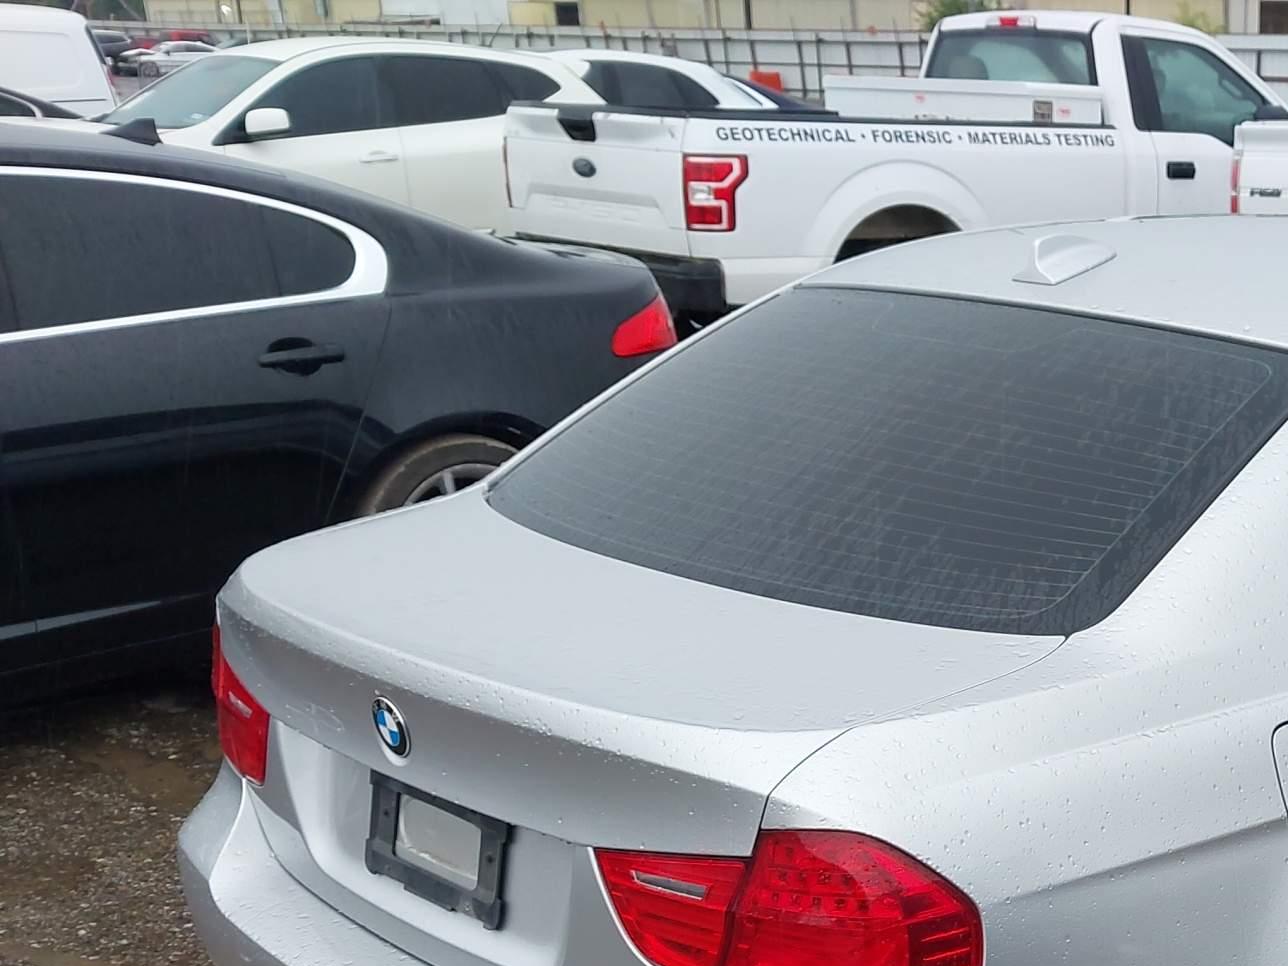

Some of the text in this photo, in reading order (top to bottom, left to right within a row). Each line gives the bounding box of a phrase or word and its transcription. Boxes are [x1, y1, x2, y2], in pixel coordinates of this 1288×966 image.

[716, 127, 1115, 148] GEOTECHNICAL FORENSIC MATERIALS TESTING
